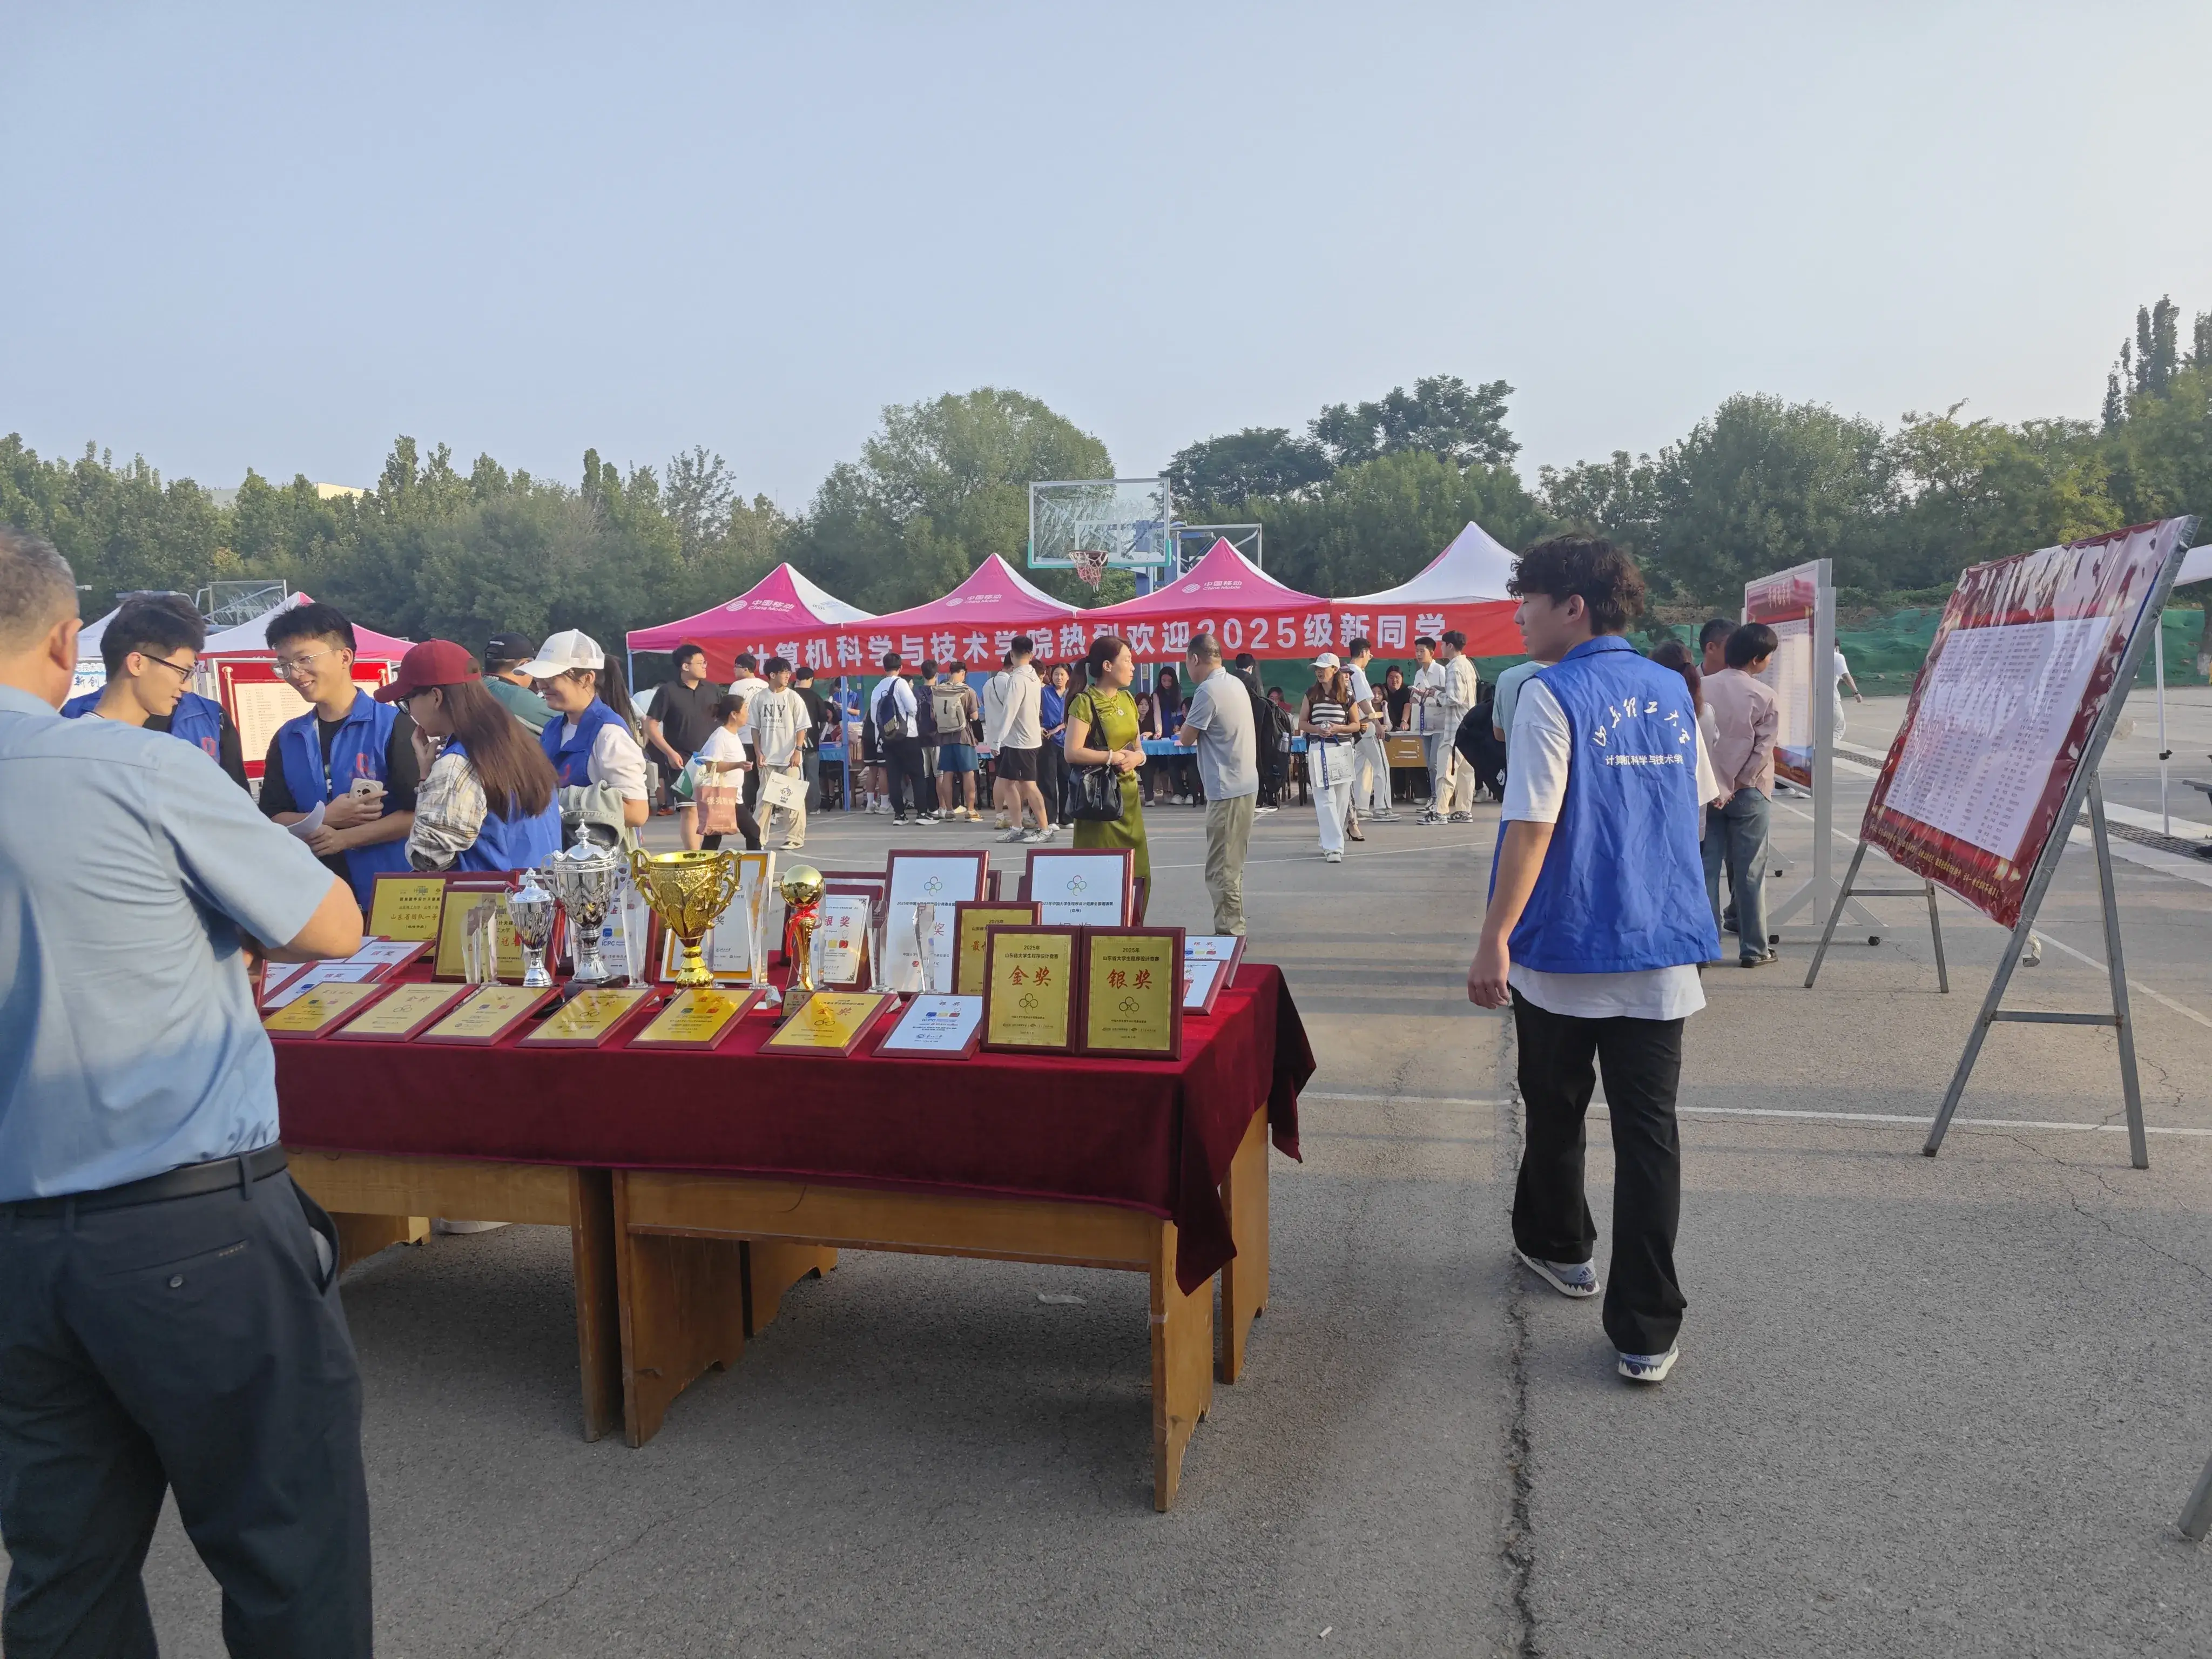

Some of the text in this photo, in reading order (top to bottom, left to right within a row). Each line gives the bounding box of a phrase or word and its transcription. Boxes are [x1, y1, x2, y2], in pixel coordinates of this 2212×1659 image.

[752, 599, 795, 609] 中国移动
[1606, 754, 1683, 766] 计算机科学与技术学
[1008, 965, 1051, 987] 金奖
[1107, 968, 1153, 990] 银奖
